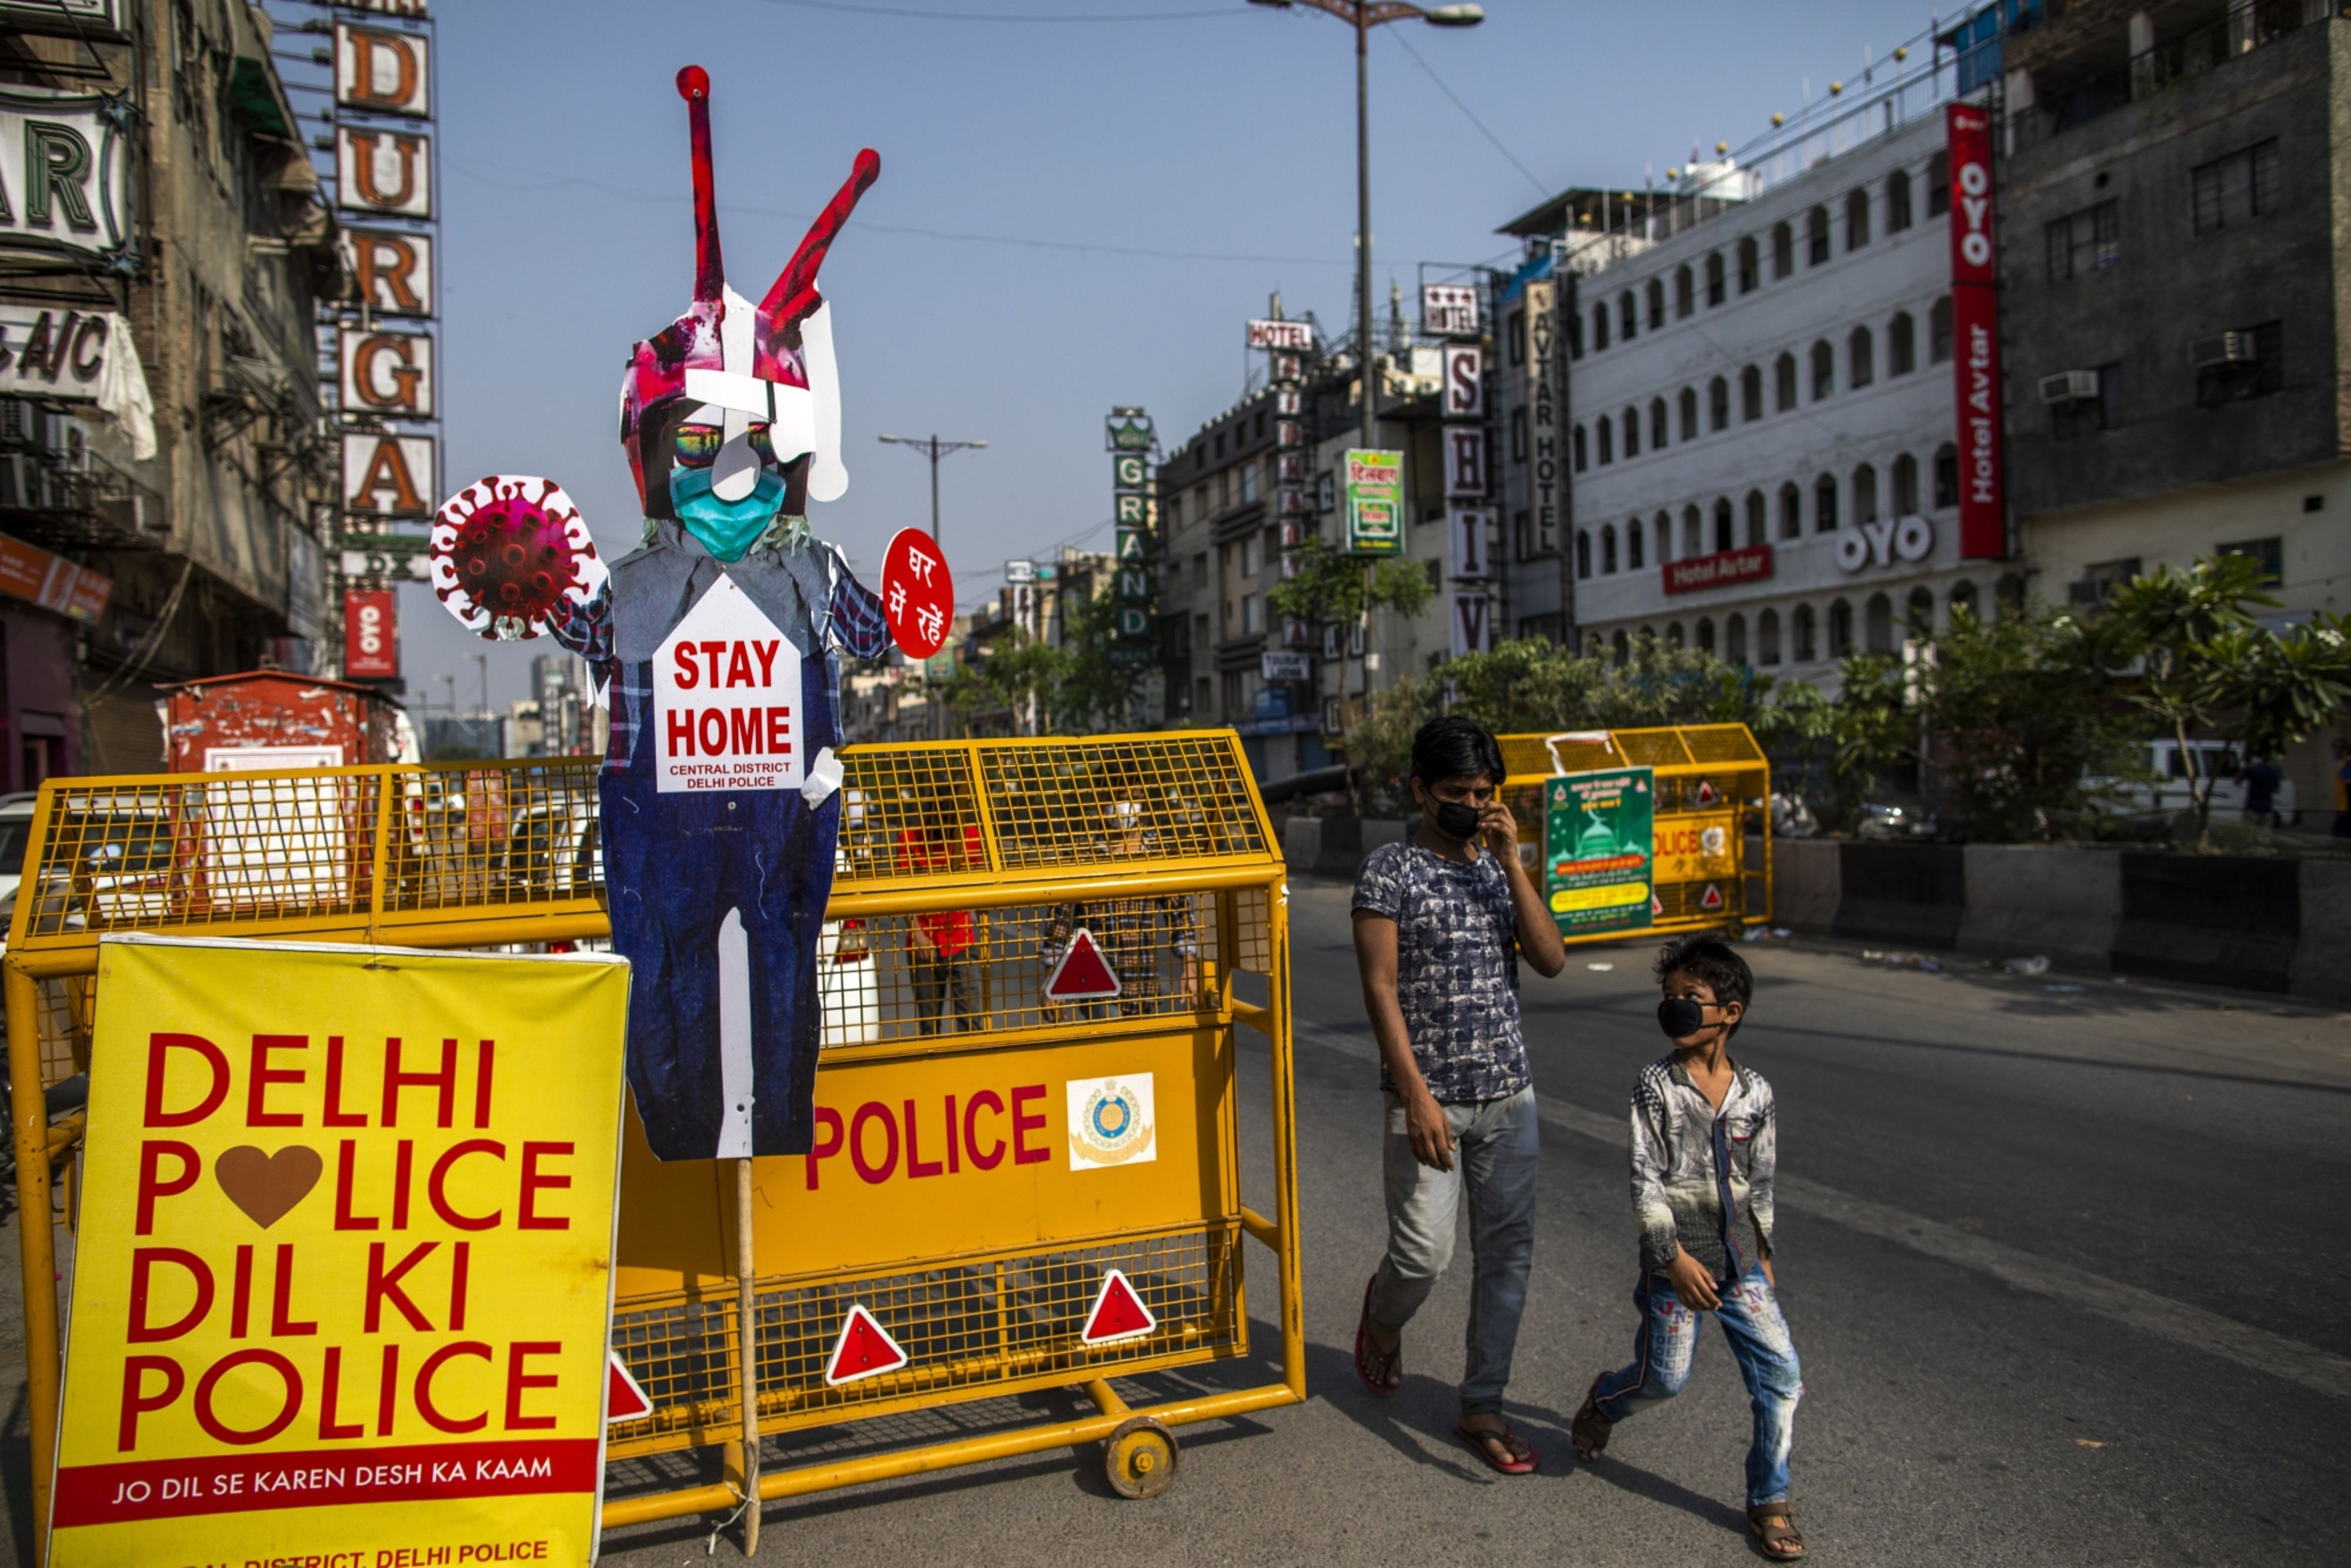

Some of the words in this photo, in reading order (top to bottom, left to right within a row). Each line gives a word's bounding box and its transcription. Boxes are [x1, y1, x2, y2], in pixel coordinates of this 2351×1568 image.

[1959, 162, 1991, 266] OYO
[347, 32, 427, 511] DURGA
[1249, 325, 1311, 350] HOTEL
[1534, 313, 1552, 425] AVTAR
[1969, 323, 1991, 413] Avtar
[1970, 417, 1993, 504] Hotel
[1538, 436, 1555, 550] HOTEL
[909, 546, 936, 587] घर
[1119, 457, 1146, 634] GRAND
[1673, 559, 1715, 586] Hotel
[1718, 554, 1763, 577] Avtar
[1836, 515, 1934, 573] OYO
[359, 606, 381, 654] OYO
[890, 580, 906, 626] में
[673, 640, 780, 690] STAY
[666, 706, 792, 758] HOME
[670, 765, 730, 775] CENTRAL
[733, 763, 790, 774] DISTRICT
[687, 778, 724, 788] DELHI
[729, 777, 774, 787] POLICE
[1653, 830, 1697, 857] OLICE
[143, 1033, 495, 1129] DELHI
[805, 1084, 1051, 1191] POLICE
[126, 1243, 318, 1344] DIL
[363, 1241, 470, 1333] KI
[118, 1340, 562, 1453] POLICE
[112, 1480, 151, 1505] JO
[162, 1476, 203, 1500] DIL
[212, 1473, 244, 1495] SE
[254, 1467, 345, 1492] KAREN
[355, 1462, 422, 1487] DESH
[432, 1460, 467, 1482] KA
[475, 1457, 552, 1481] KAAM
[376, 1546, 451, 1568] DELHI
[459, 1541, 548, 1564] POLICE
